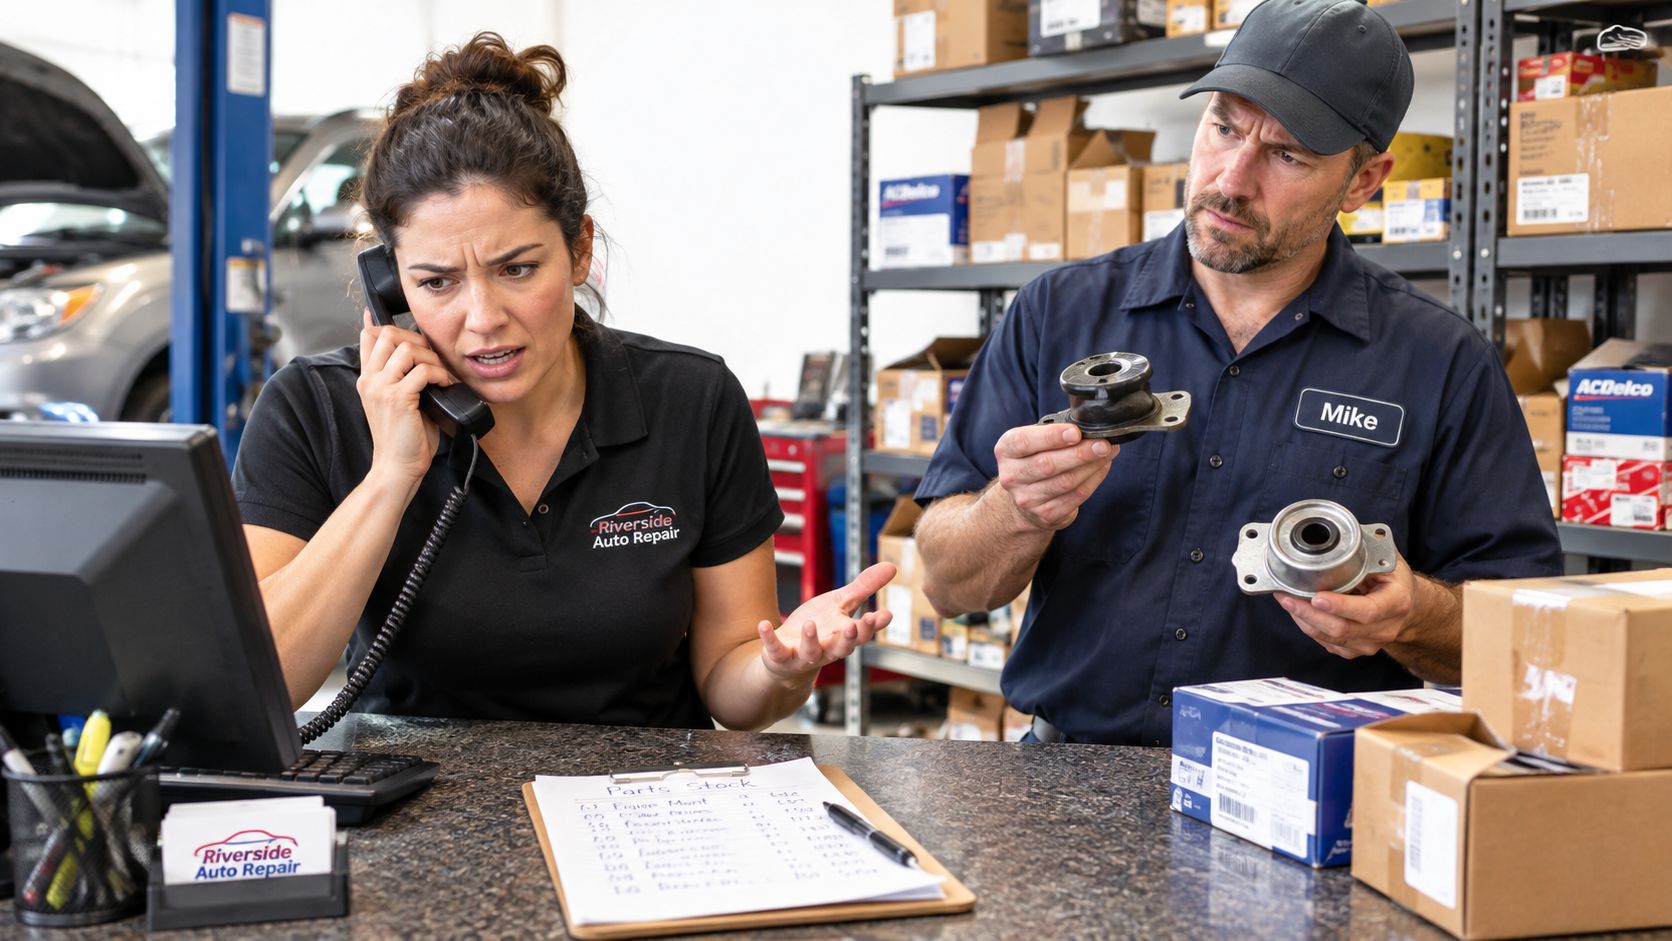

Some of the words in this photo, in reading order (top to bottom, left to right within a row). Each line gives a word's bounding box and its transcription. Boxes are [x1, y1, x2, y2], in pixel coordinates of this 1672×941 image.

[1576, 378, 1654, 397] ACDelco
[1320, 402, 1378, 430] Mike
[599, 514, 672, 534] Riverside
[592, 534, 630, 549] Auto
[633, 526, 680, 545] Repair
[606, 784, 671, 796] Parts
[686, 778, 756, 791] Stock
[203, 845, 292, 864] Riverside
[195, 864, 238, 880] Auto
[243, 860, 300, 878] Repair
